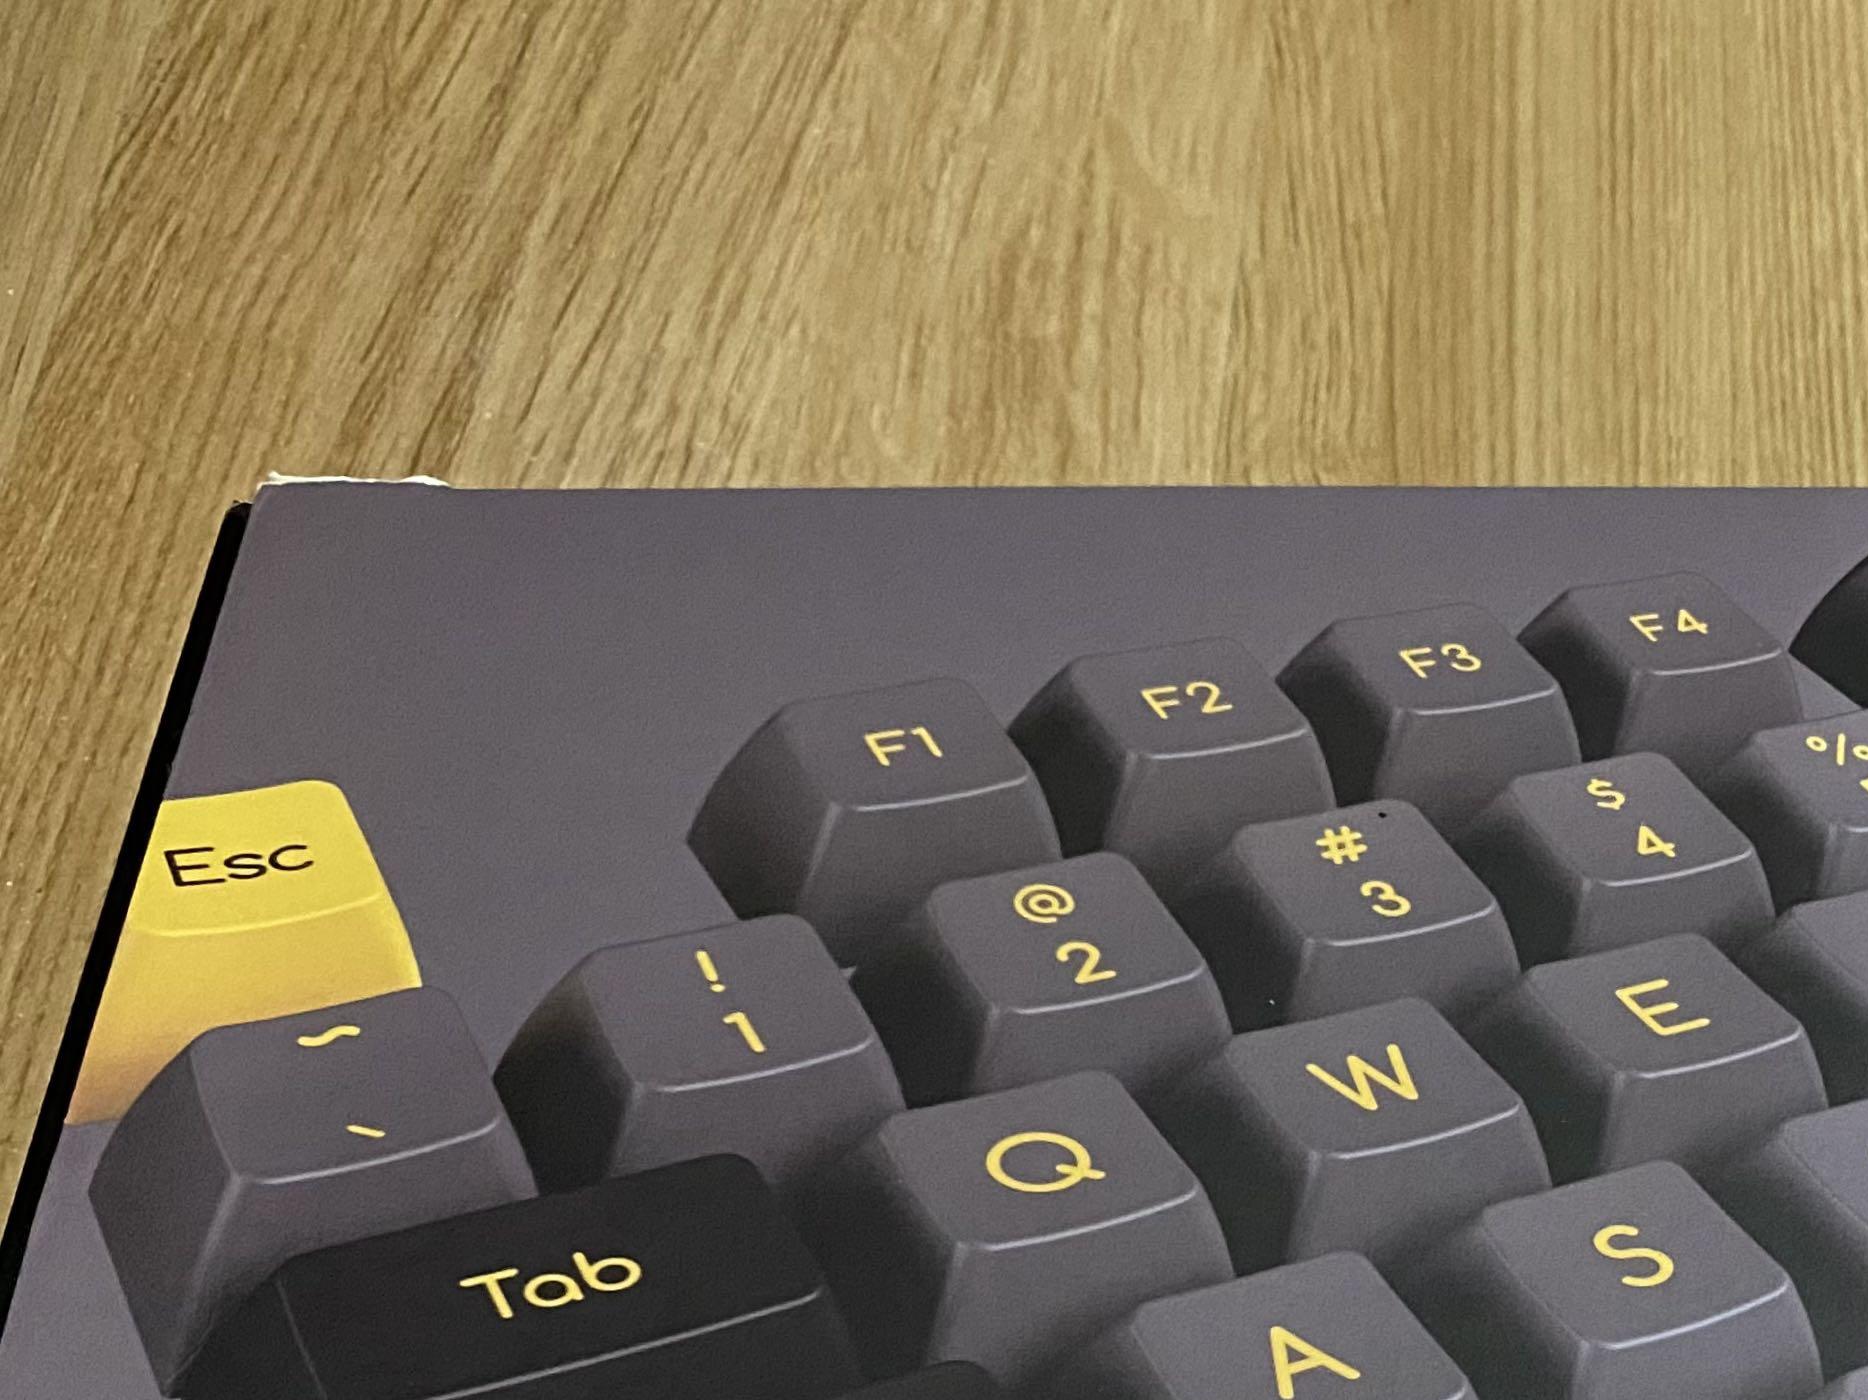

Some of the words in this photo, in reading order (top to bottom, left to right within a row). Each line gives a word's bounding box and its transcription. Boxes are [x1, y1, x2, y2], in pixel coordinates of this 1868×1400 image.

[1629, 609, 1708, 642] F4
[1399, 643, 1482, 679] F3
[1141, 681, 1233, 720] F2
[864, 726, 943, 767] F1
[1586, 778, 1626, 811] $
[1315, 825, 1368, 865] #
[1637, 825, 1676, 858] 4
[163, 843, 315, 888] Esc
[1013, 883, 1075, 924] @
[1360, 880, 1411, 917] 3
[696, 950, 725, 993] !
[1056, 941, 1117, 984] 2
[1614, 978, 1711, 1036] E
[723, 1011, 765, 1053] 1
[1305, 1043, 1419, 1111] W
[985, 1131, 1106, 1193] Q
[1593, 1224, 1674, 1287] S
[459, 1252, 642, 1319] Tab
[1270, 1326, 1361, 1400] A
